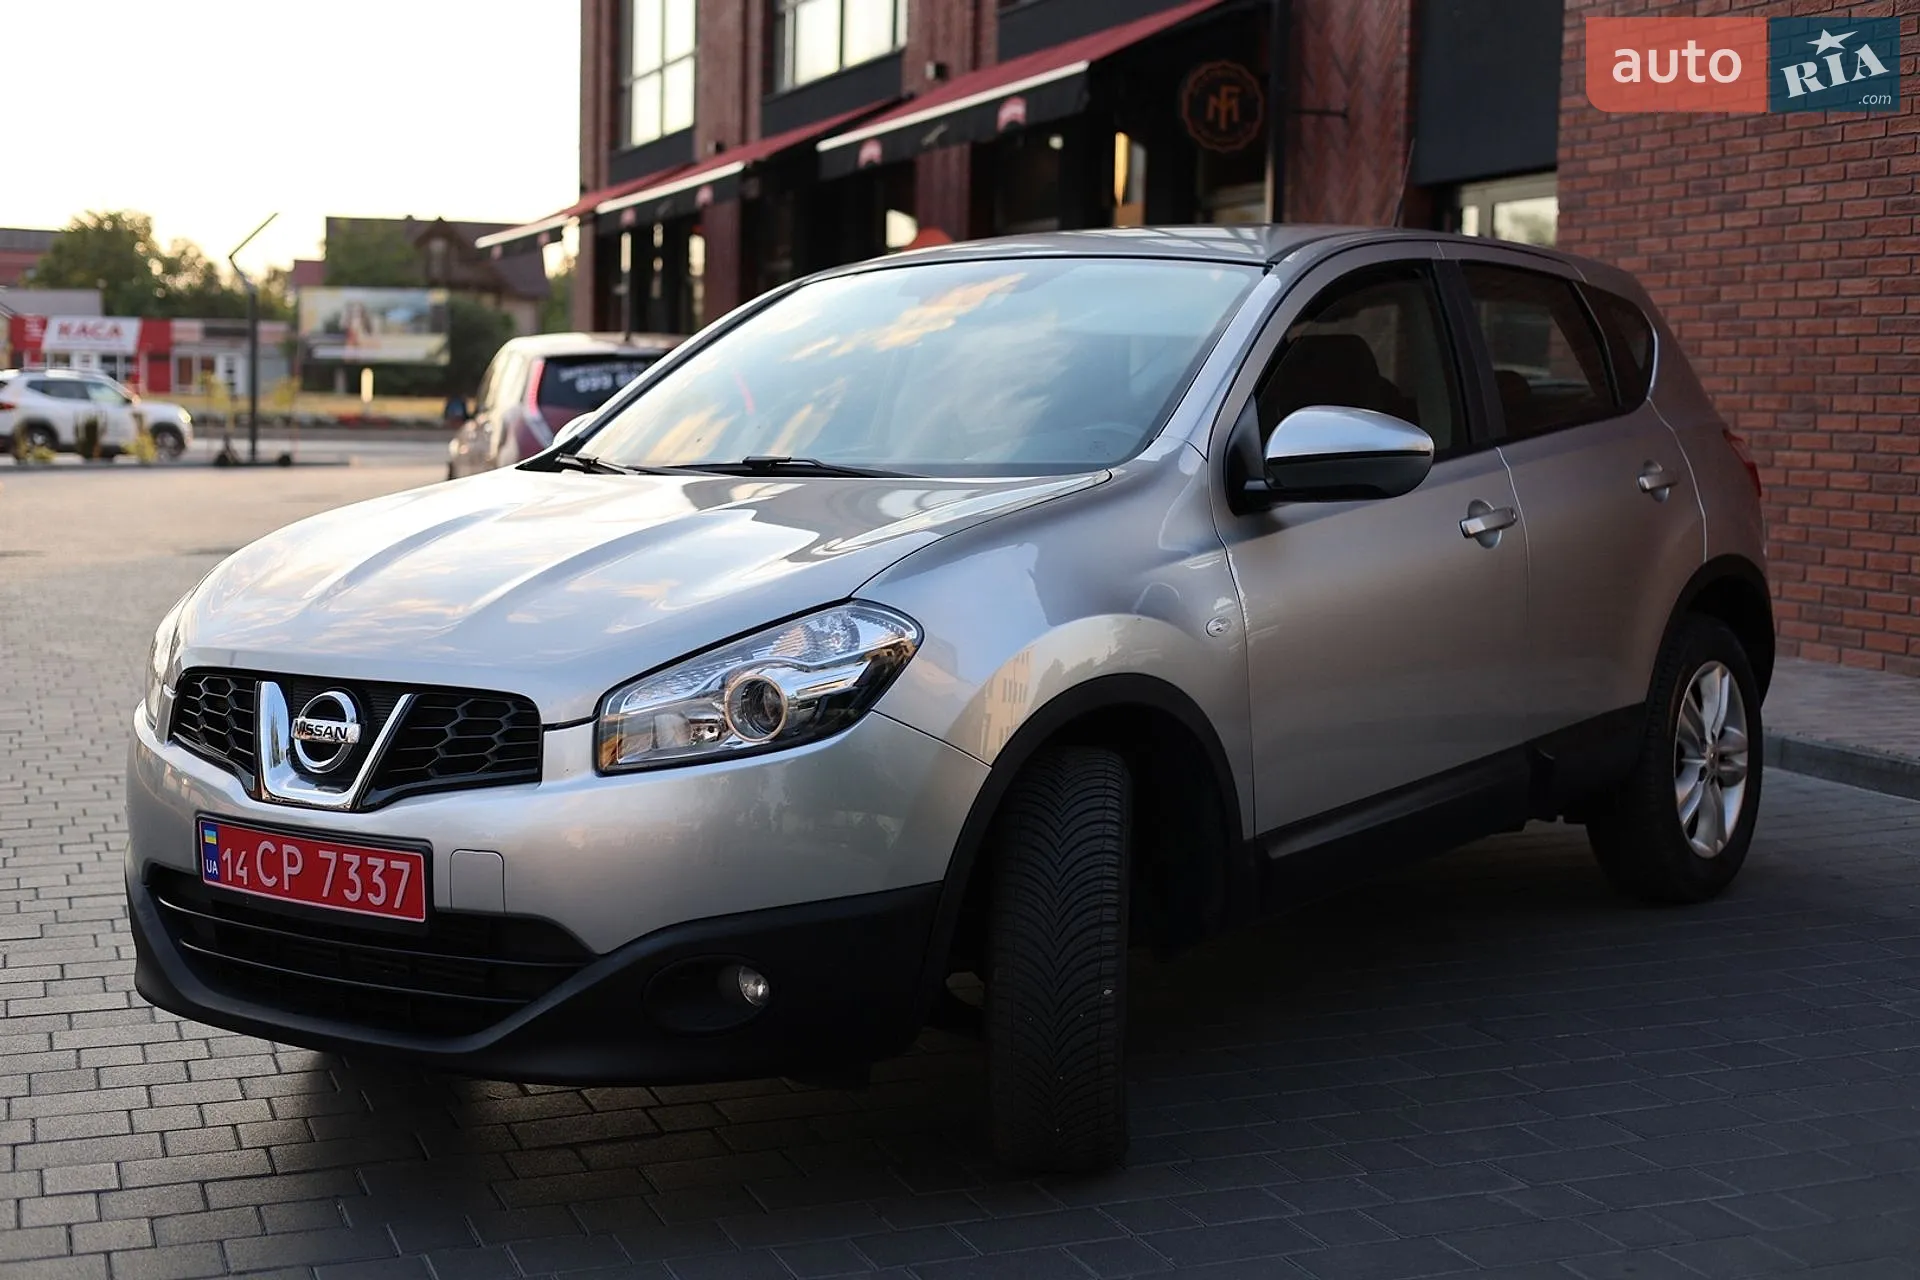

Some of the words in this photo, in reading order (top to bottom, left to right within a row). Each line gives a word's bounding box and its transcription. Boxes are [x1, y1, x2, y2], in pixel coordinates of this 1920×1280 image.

[294, 720, 348, 740] NISSAN
[206, 858, 219, 876] UA
[318, 850, 411, 909] 7337
